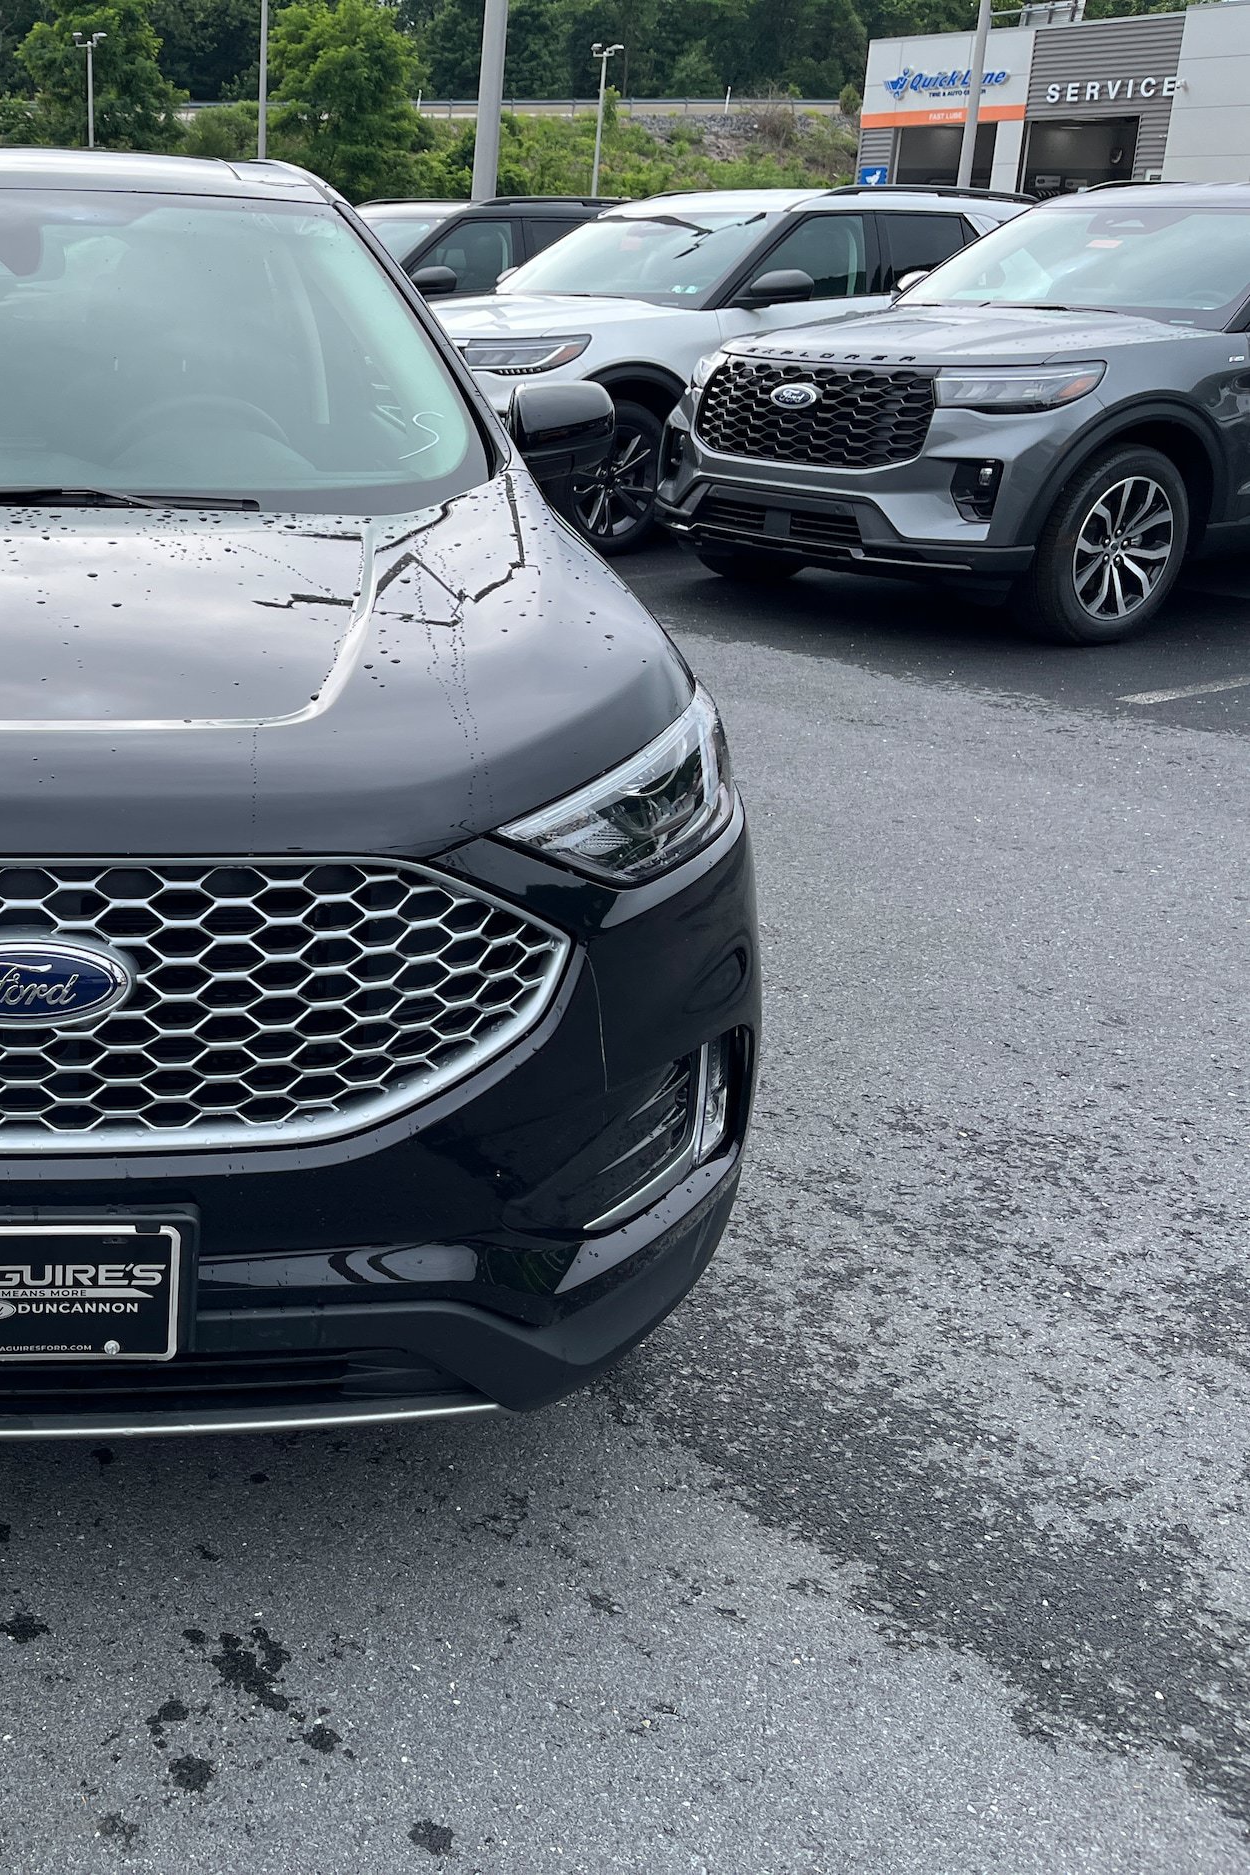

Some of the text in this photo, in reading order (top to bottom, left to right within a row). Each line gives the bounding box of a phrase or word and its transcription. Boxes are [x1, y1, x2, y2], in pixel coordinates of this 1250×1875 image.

[910, 69, 1007, 91] Quick Lne
[1046, 77, 1176, 103] SERVICE
[746, 347, 916, 362] EXPLORER
[17, 1302, 139, 1314] DUNCANNON
